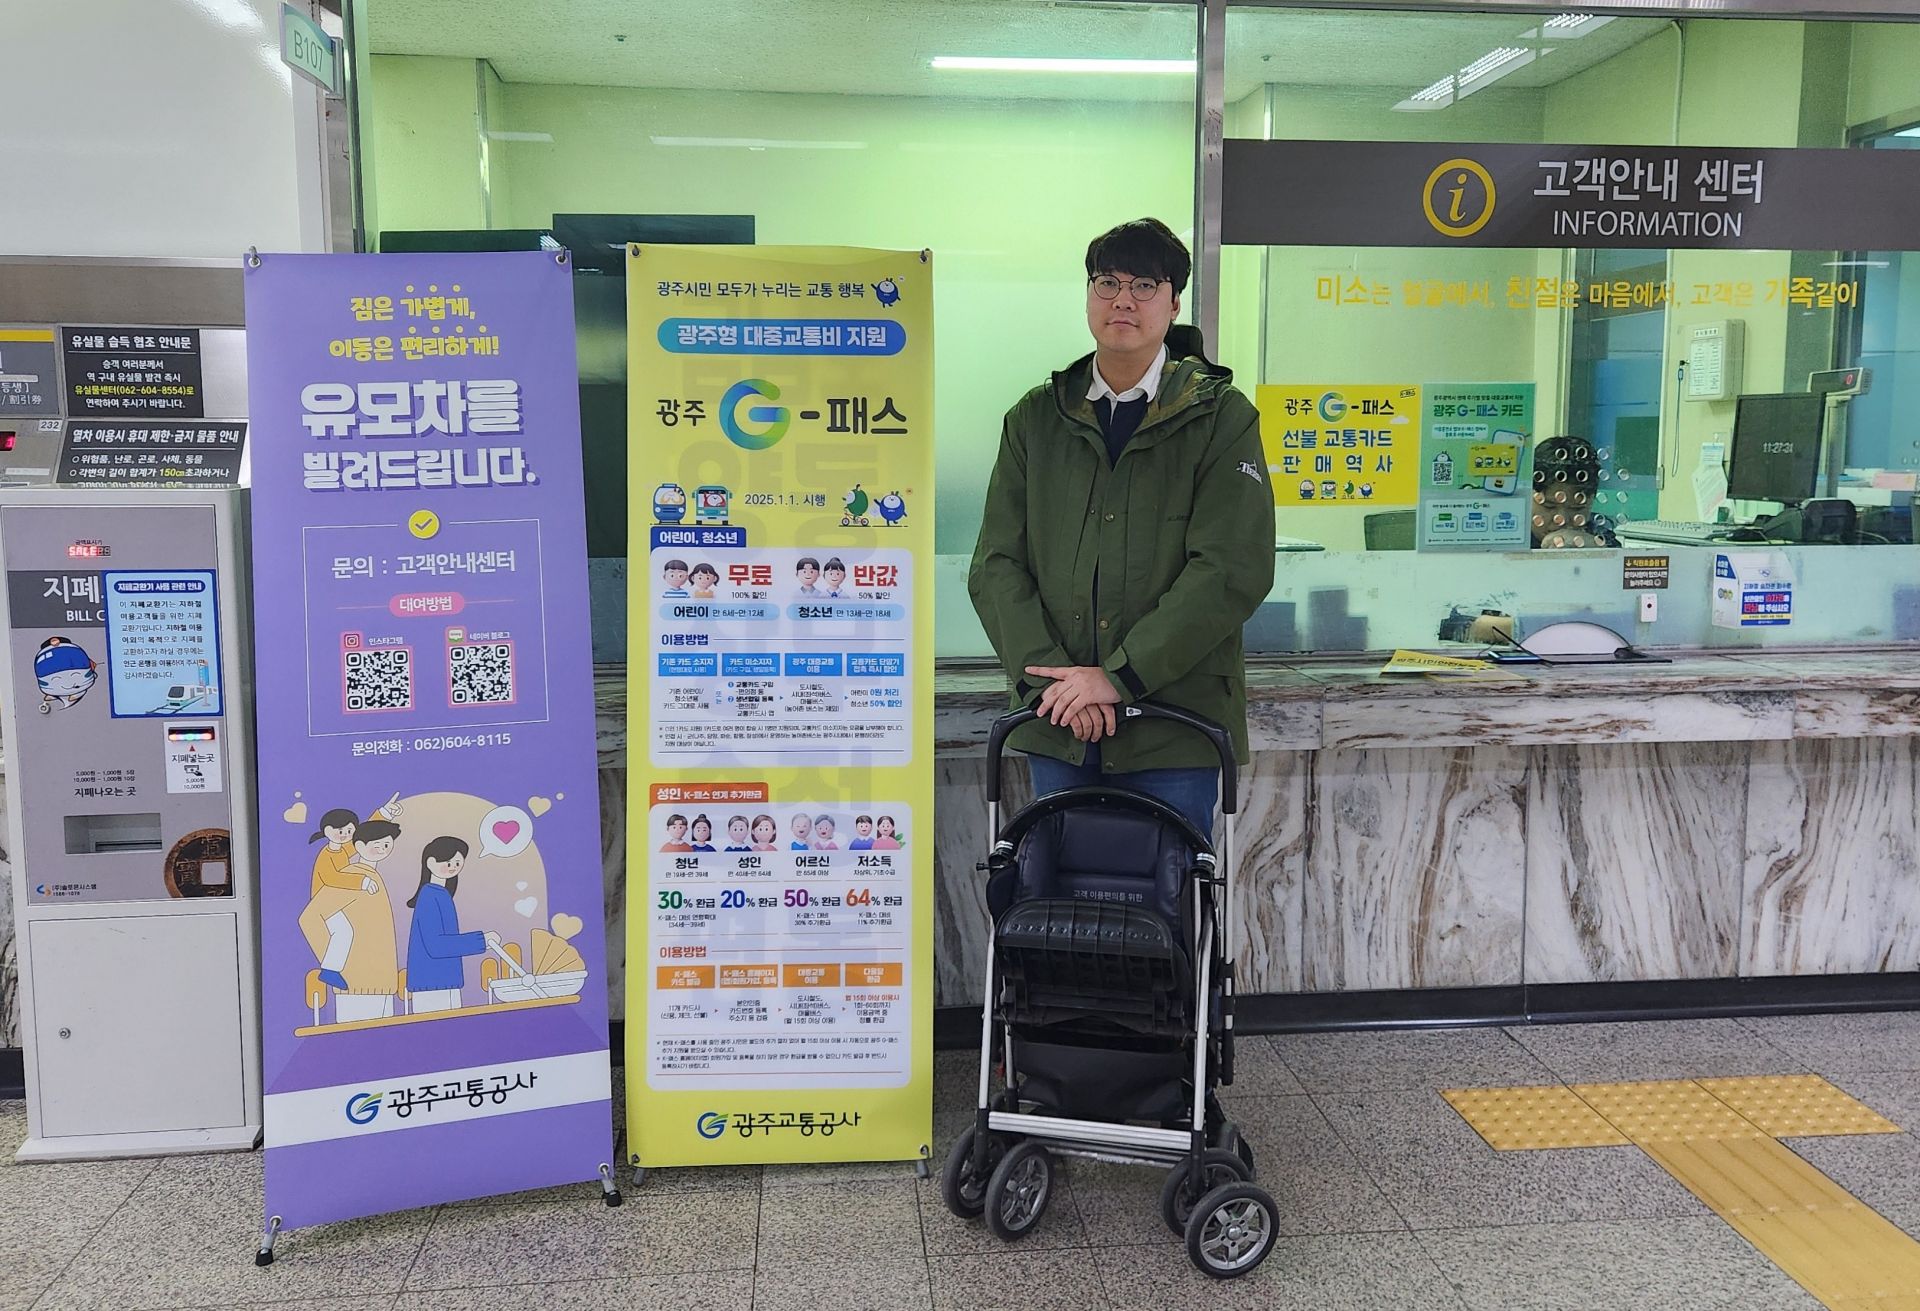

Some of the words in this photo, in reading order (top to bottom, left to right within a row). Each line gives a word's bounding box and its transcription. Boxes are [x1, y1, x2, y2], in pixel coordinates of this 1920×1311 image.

[294, 29, 323, 72] B107
[1533, 158, 1679, 202] 고객안내
[1693, 159, 1764, 204] 센터
[1553, 210, 1742, 237] INFORMATION
[656, 281, 711, 297] 광주시민
[716, 282, 757, 297] 모두가
[761, 282, 802, 298] 누리는
[806, 283, 833, 298] 교통
[838, 283, 865, 298] 행복
[1316, 274, 1392, 306] 미소는
[1506, 274, 1581, 309] 친절은
[1589, 280, 1681, 309] 마음에서,
[1690, 281, 1754, 309] 고객은
[1764, 276, 1858, 309] 가족같이
[350, 296, 394, 321] 짐은
[400, 296, 475, 321] 가볍게,
[72, 335, 105, 349] 유실물
[108, 335, 130, 349] 습득
[133, 335, 156, 349] 협조
[158, 336, 192, 349] 안내문
[677, 325, 738, 346] 광주형
[743, 325, 841, 347] 대중교통비
[847, 326, 886, 347] 지원
[329, 336, 394, 361] 이동은
[400, 335, 499, 360] 편리하게!
[102, 360, 120, 370] 승객
[122, 360, 164, 370] 여러분께서
[86, 372, 96, 382] 역
[98, 372, 115, 382] 구내
[117, 372, 142, 382] 유실물
[145, 373, 162, 382] 발견
[164, 373, 181, 382] 즉시
[75, 385, 195, 396] 유실물센터(062-604-8554)로
[85, 398, 120, 409] 연락하여
[122, 399, 147, 409] 주시기
[149, 399, 186, 409] 바랍니다.
[300, 379, 524, 440] 유모차를
[1284, 398, 1313, 416] 광주
[656, 399, 706, 427] 광주
[1434, 404, 1456, 417] 광주
[1501, 404, 1524, 417] 카드
[40, 421, 59, 429] 232
[73, 429, 93, 443] 열차
[95, 429, 125, 443] 이용시
[127, 429, 148, 443] 휴대
[150, 429, 194, 443] 제한·금지
[197, 430, 216, 443] 물품
[219, 430, 239, 443] 안내
[1282, 429, 1318, 449] 선불
[1324, 429, 1393, 449] 교통카드
[81, 455, 111, 465] 위험품,
[113, 455, 135, 465] 난로,
[137, 455, 158, 465] 곤로,
[184, 455, 203, 465] 동물
[78, 467, 106, 478] 각변의
[108, 467, 127, 478] 길이
[129, 467, 156, 478] 합계가
[303, 447, 539, 490] 빌려드립니다.
[744, 494, 799, 507] 2025.1.1.
[803, 493, 826, 507] 시행
[659, 532, 699, 545] 어린이,
[702, 532, 738, 545] 청소년
[331, 556, 374, 579] 문의
[395, 550, 516, 576] 고객안내센터
[728, 564, 773, 586] 무료
[854, 565, 898, 587] 반값
[731, 591, 750, 600] 100%
[752, 591, 767, 600] 할인
[858, 591, 874, 600] 50%
[875, 591, 891, 600] 할인
[399, 596, 453, 612] 대여방법
[66, 610, 93, 621] BILL
[673, 606, 709, 618] 어린이
[798, 606, 833, 618] 청소년
[368, 636, 404, 646] 인스타그램
[469, 631, 490, 641] 네이버
[490, 631, 510, 641] 블로그
[661, 634, 709, 646] 이용방법
[351, 739, 403, 756] 문의전화
[414, 733, 511, 751] 062)604-8115
[171, 753, 215, 763] 지폐넣는곳
[74, 787, 124, 798] 지폐나오는
[126, 786, 136, 796] 곳
[657, 788, 681, 800] 성인
[675, 858, 699, 869] 청년
[738, 857, 761, 868] 성인
[795, 856, 830, 868] 어르신
[857, 855, 892, 867] 저소득
[657, 890, 693, 910] 30%
[696, 898, 716, 909] 환급
[720, 889, 755, 909] 20%
[758, 897, 778, 908] 환급
[783, 888, 819, 908] 50%
[821, 896, 841, 907] 환급
[846, 888, 881, 907] 64%
[883, 896, 903, 906] 환급
[1073, 889, 1088, 900] 고객
[659, 946, 707, 958] 이용방법
[387, 1071, 538, 1118] 광주교통공사
[731, 1111, 861, 1138] 광주교통공사
